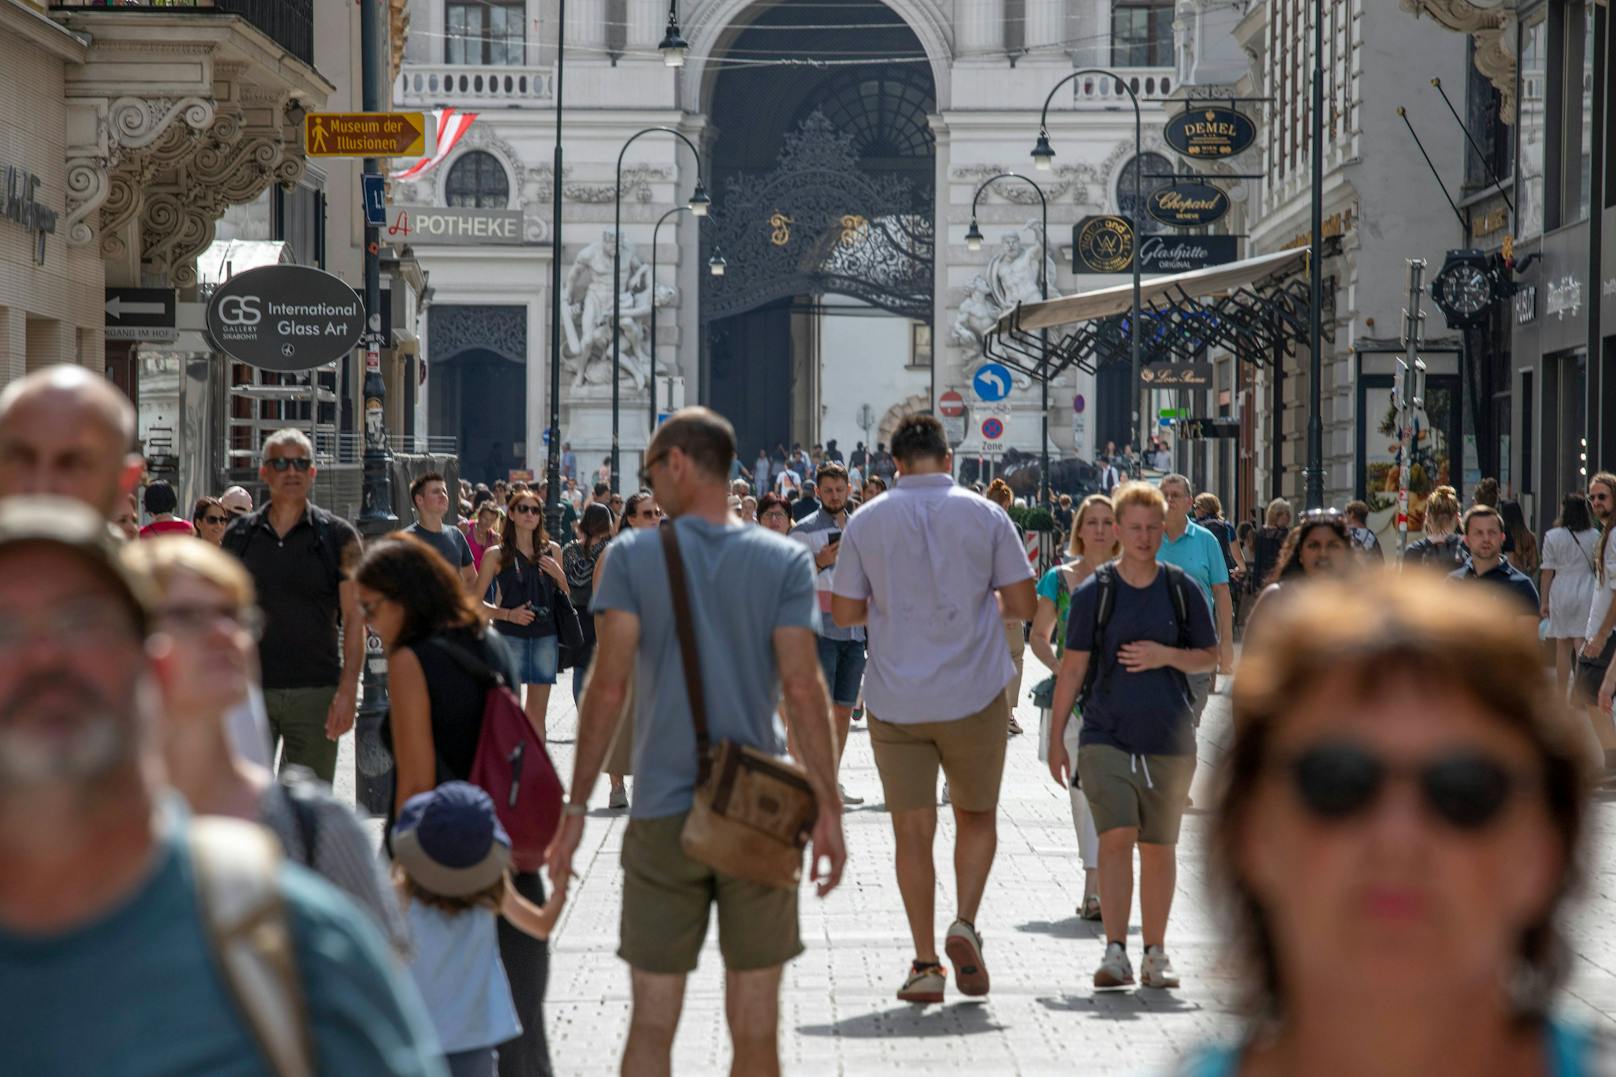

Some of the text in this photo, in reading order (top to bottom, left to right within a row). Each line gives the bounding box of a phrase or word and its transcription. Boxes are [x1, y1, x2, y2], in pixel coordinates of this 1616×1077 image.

[330, 120, 403, 133] Museum der
[1184, 122, 1236, 136] DEMEL
[337, 136, 397, 150] Illusionen
[1155, 191, 1222, 213] Chopard
[388, 210, 517, 237] APOTHEKE
[1104, 220, 1127, 234] and
[1159, 261, 1191, 269] ORIGINAL
[218, 295, 262, 325] GS
[268, 302, 357, 317] International
[277, 321, 349, 337] Glass Art
[982, 441, 1003, 451] Zone
